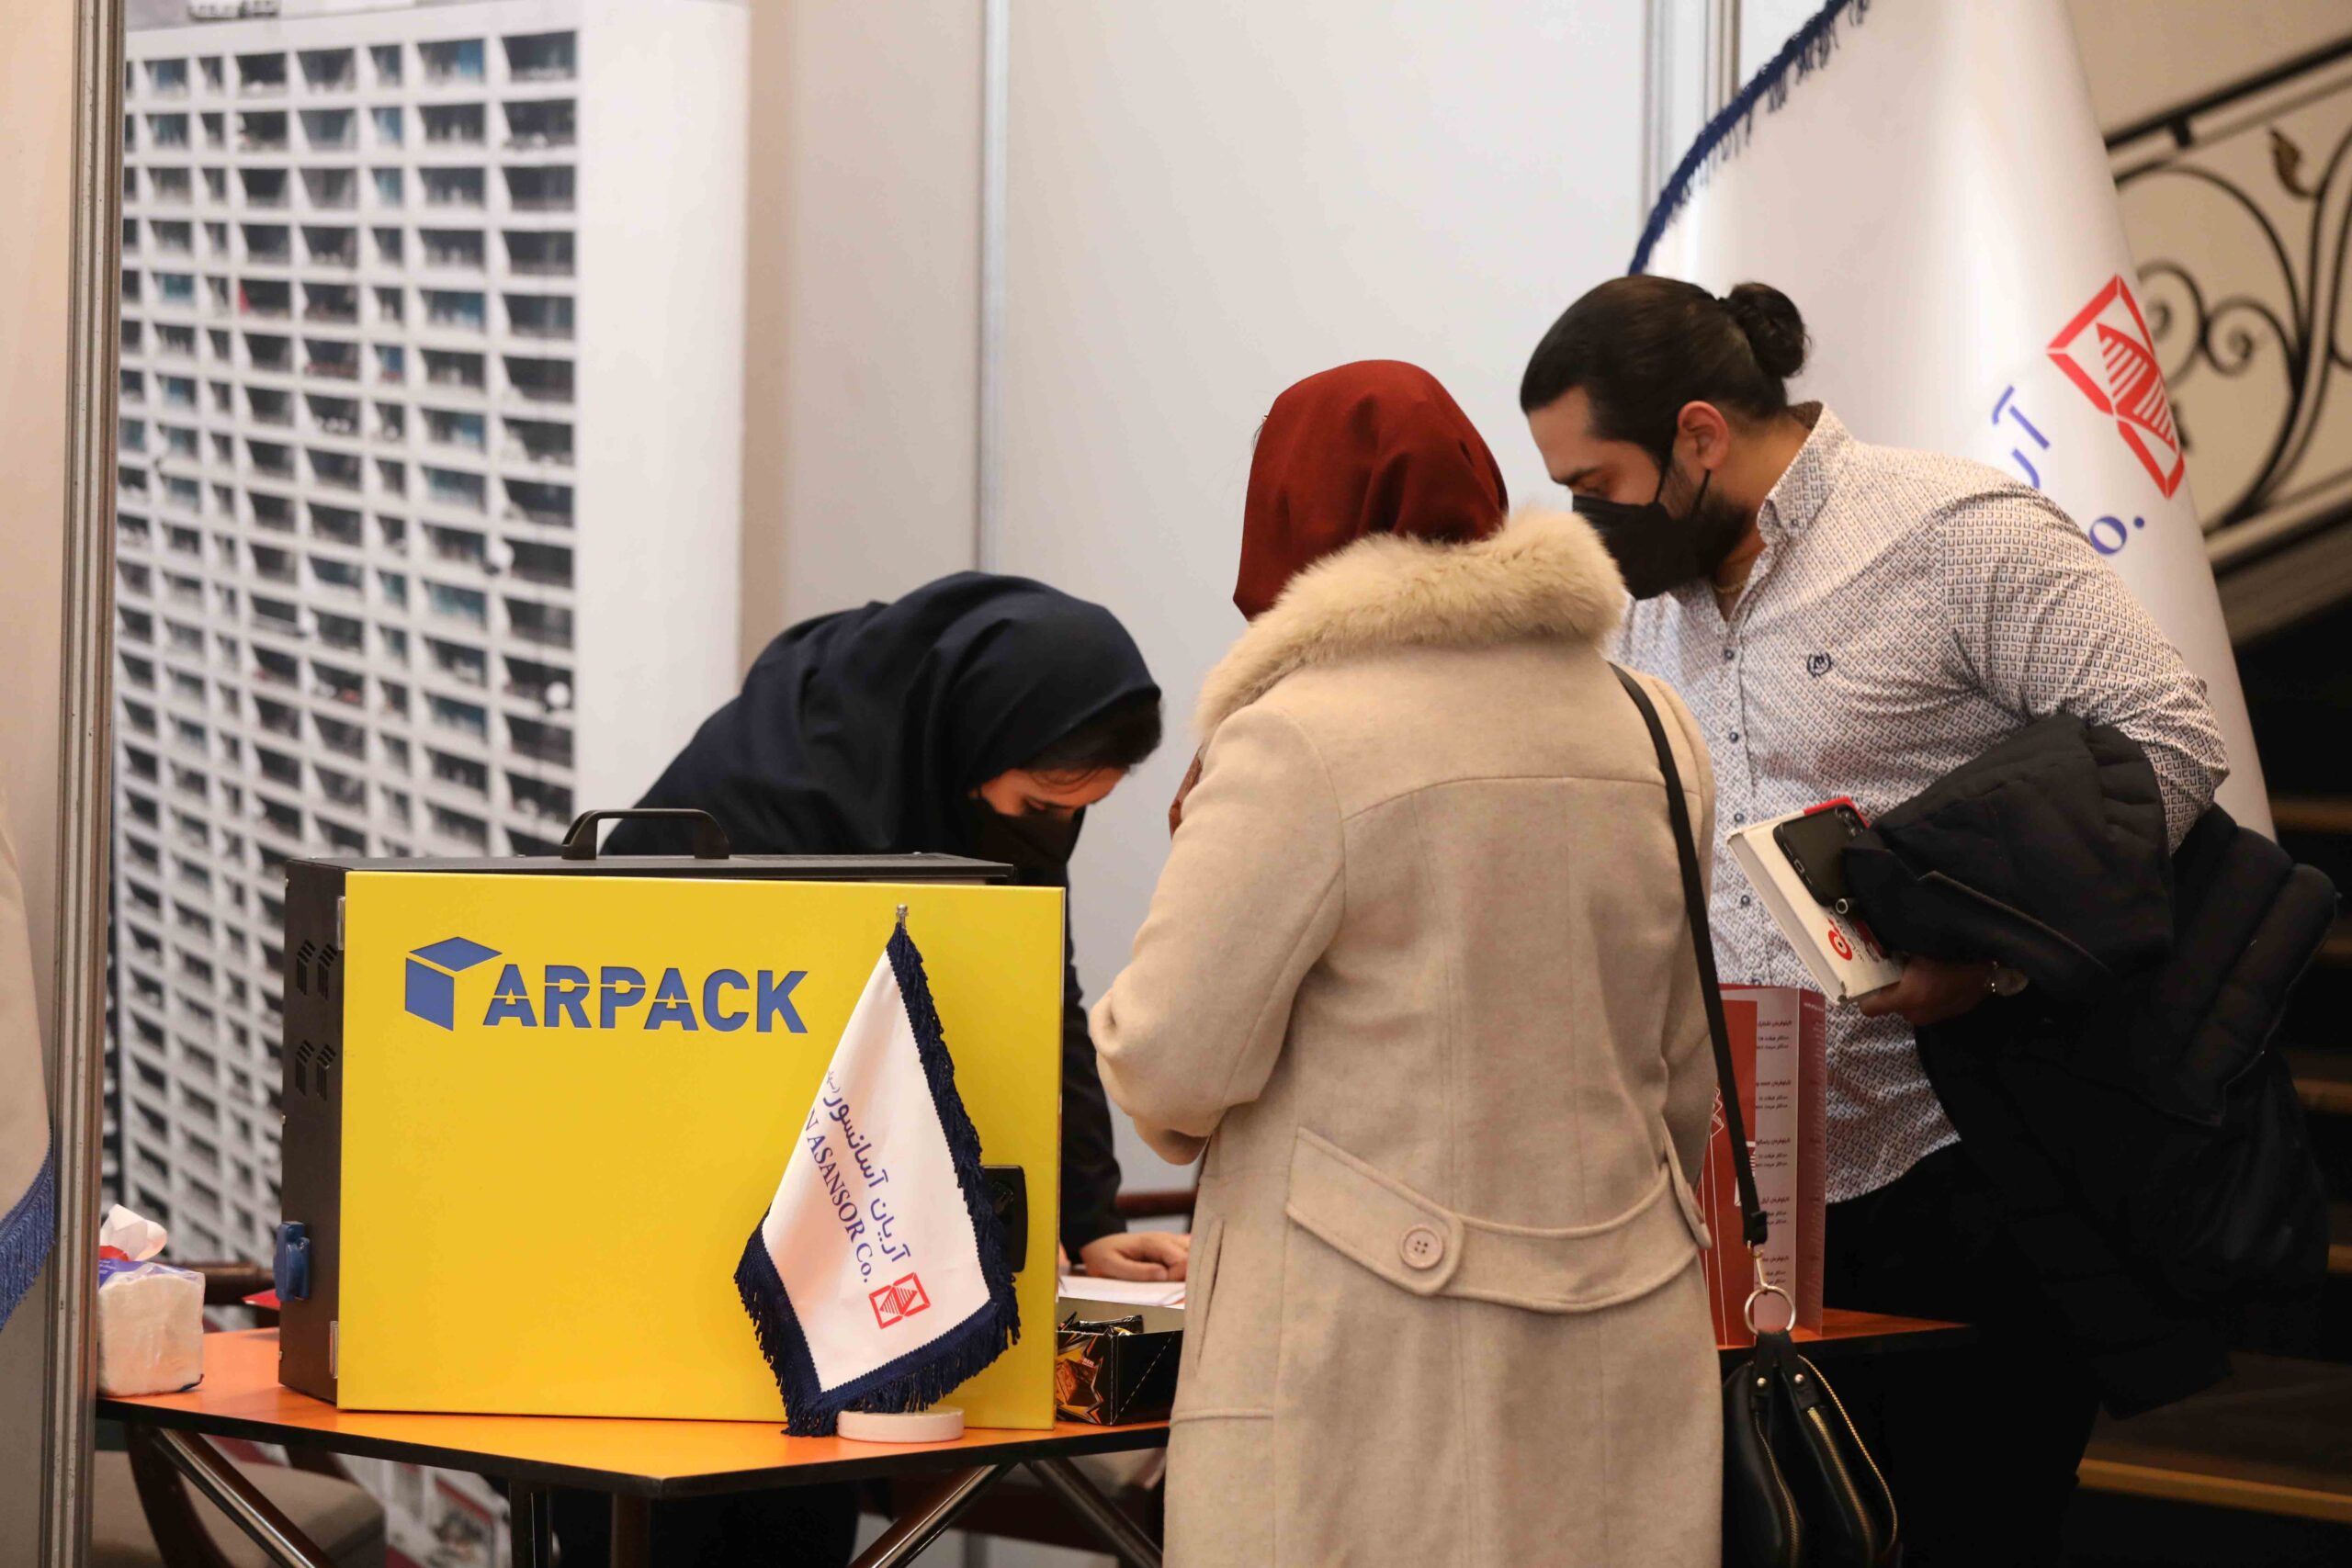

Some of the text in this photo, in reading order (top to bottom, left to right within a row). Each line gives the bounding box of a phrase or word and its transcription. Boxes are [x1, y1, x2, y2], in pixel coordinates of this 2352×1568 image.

[2088, 515, 2145, 556] o.
[482, 963, 808, 1034] ARPACK
[806, 1134, 866, 1244] ASANSOR
[855, 1242, 874, 1283] Co.
[822, 1096, 911, 1263] آریان آسانسور
